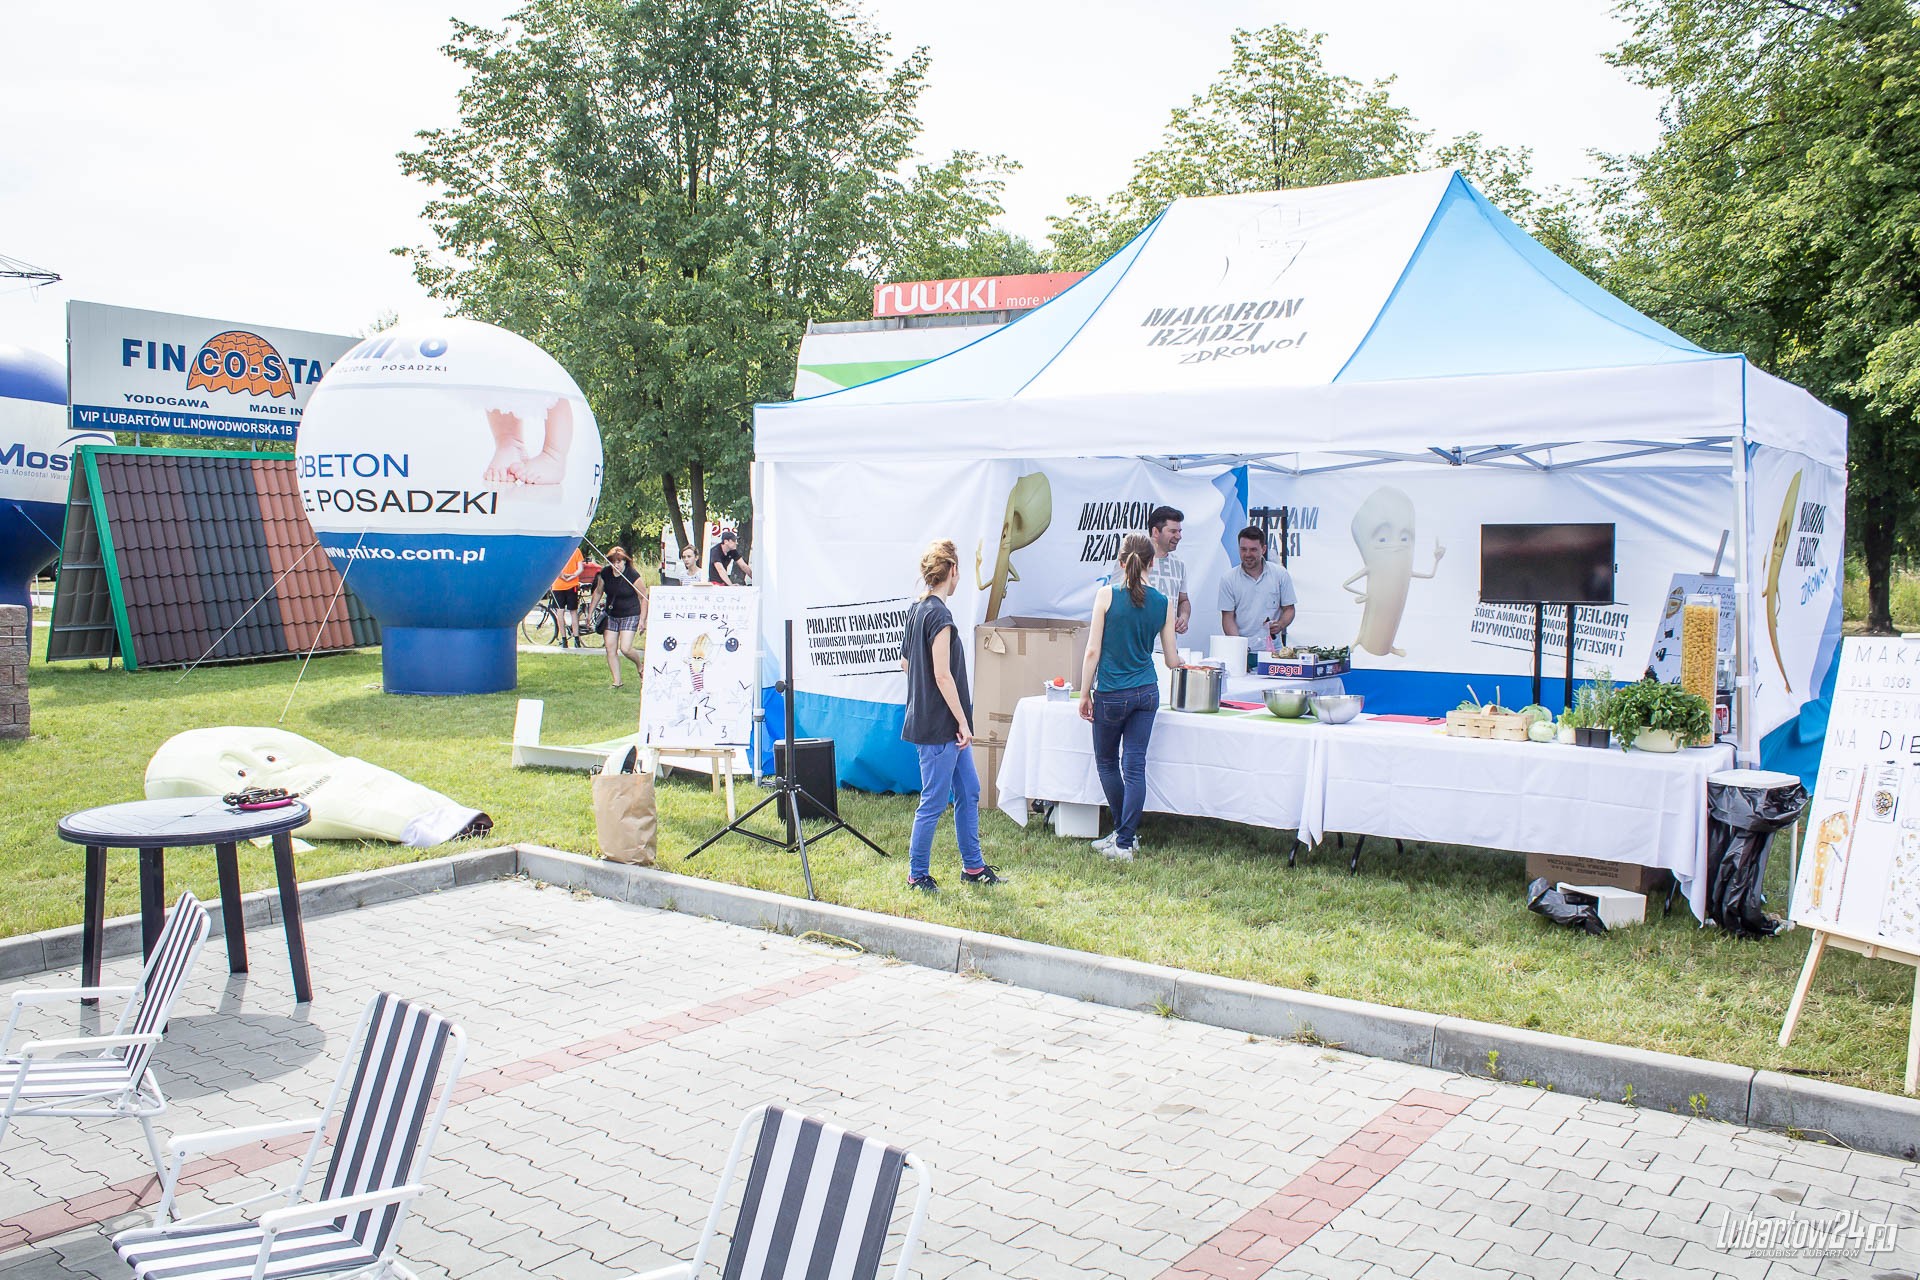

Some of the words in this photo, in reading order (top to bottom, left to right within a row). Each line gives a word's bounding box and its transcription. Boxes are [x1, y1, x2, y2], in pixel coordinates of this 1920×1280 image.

[1006, 295, 1040, 307] more
[1140, 297, 1304, 327] MAKARON
[381, 363, 448, 373] POSADZKI
[123, 393, 210, 409] YODOGAWA
[249, 404, 287, 415] MADE
[290, 406, 304, 417] IN
[79, 410, 100, 423] VIP
[103, 412, 171, 428] LUBARTÓW
[280, 424, 293, 436] 1B
[316, 488, 498, 515] POSADZKI
[1077, 501, 1154, 531] MAKARON
[1080, 533, 1127, 566] RZĄD
[806, 615, 847, 635] PROJEKT
[813, 635, 847, 648] FUNDUSZU
[1268, 664, 1303, 676] gregal
[658, 725, 665, 739] 2
[720, 725, 728, 739] 3
